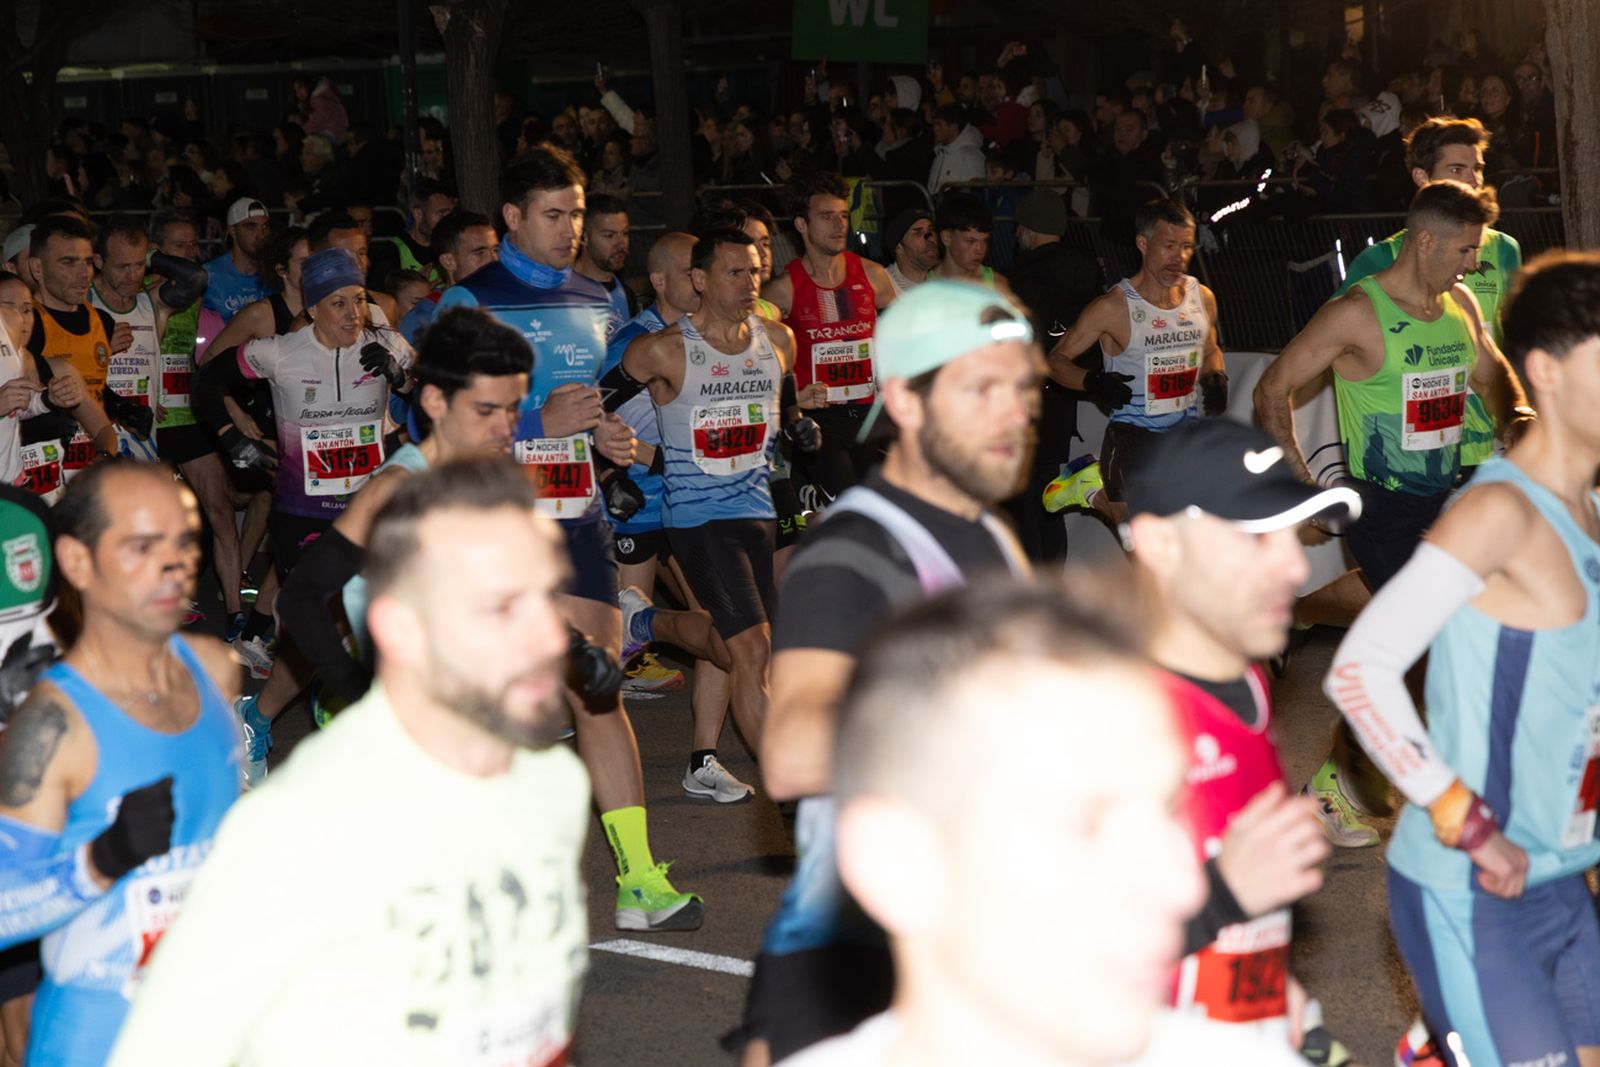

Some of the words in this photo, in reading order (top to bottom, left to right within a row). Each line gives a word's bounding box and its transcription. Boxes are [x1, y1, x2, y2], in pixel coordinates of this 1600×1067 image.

[1144, 329, 1201, 346] MARACENA
[1426, 341, 1465, 355] Fundación
[1428, 354, 1460, 366] Unicaja
[828, 361, 864, 382] 9471
[700, 379, 772, 396] MARACENA
[1422, 379, 1441, 389] NOCHE
[1412, 391, 1428, 400] SAN
[733, 408, 741, 416] DE
[1419, 397, 1462, 423] 9634
[707, 426, 757, 451] 9420
[536, 442, 559, 451] NOCHE
[526, 454, 543, 463] SAN
[535, 464, 582, 490] 6447
